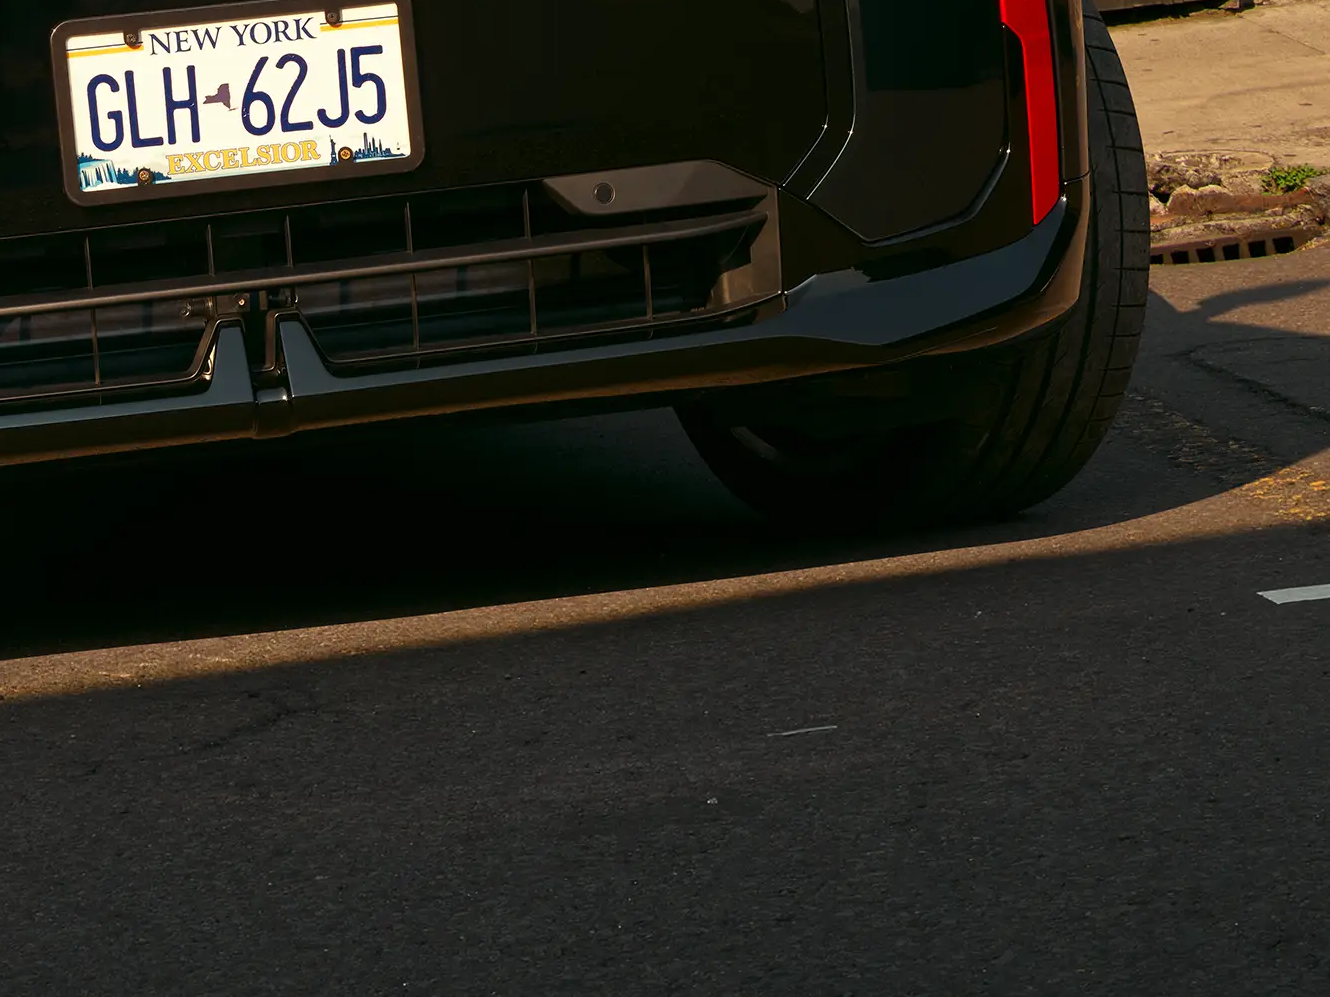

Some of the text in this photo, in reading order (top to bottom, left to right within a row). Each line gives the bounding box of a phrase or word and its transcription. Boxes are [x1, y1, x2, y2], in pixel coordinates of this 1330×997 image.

[149, 16, 318, 57] NEW YORK
[165, 139, 322, 176] EXCELSIOR
